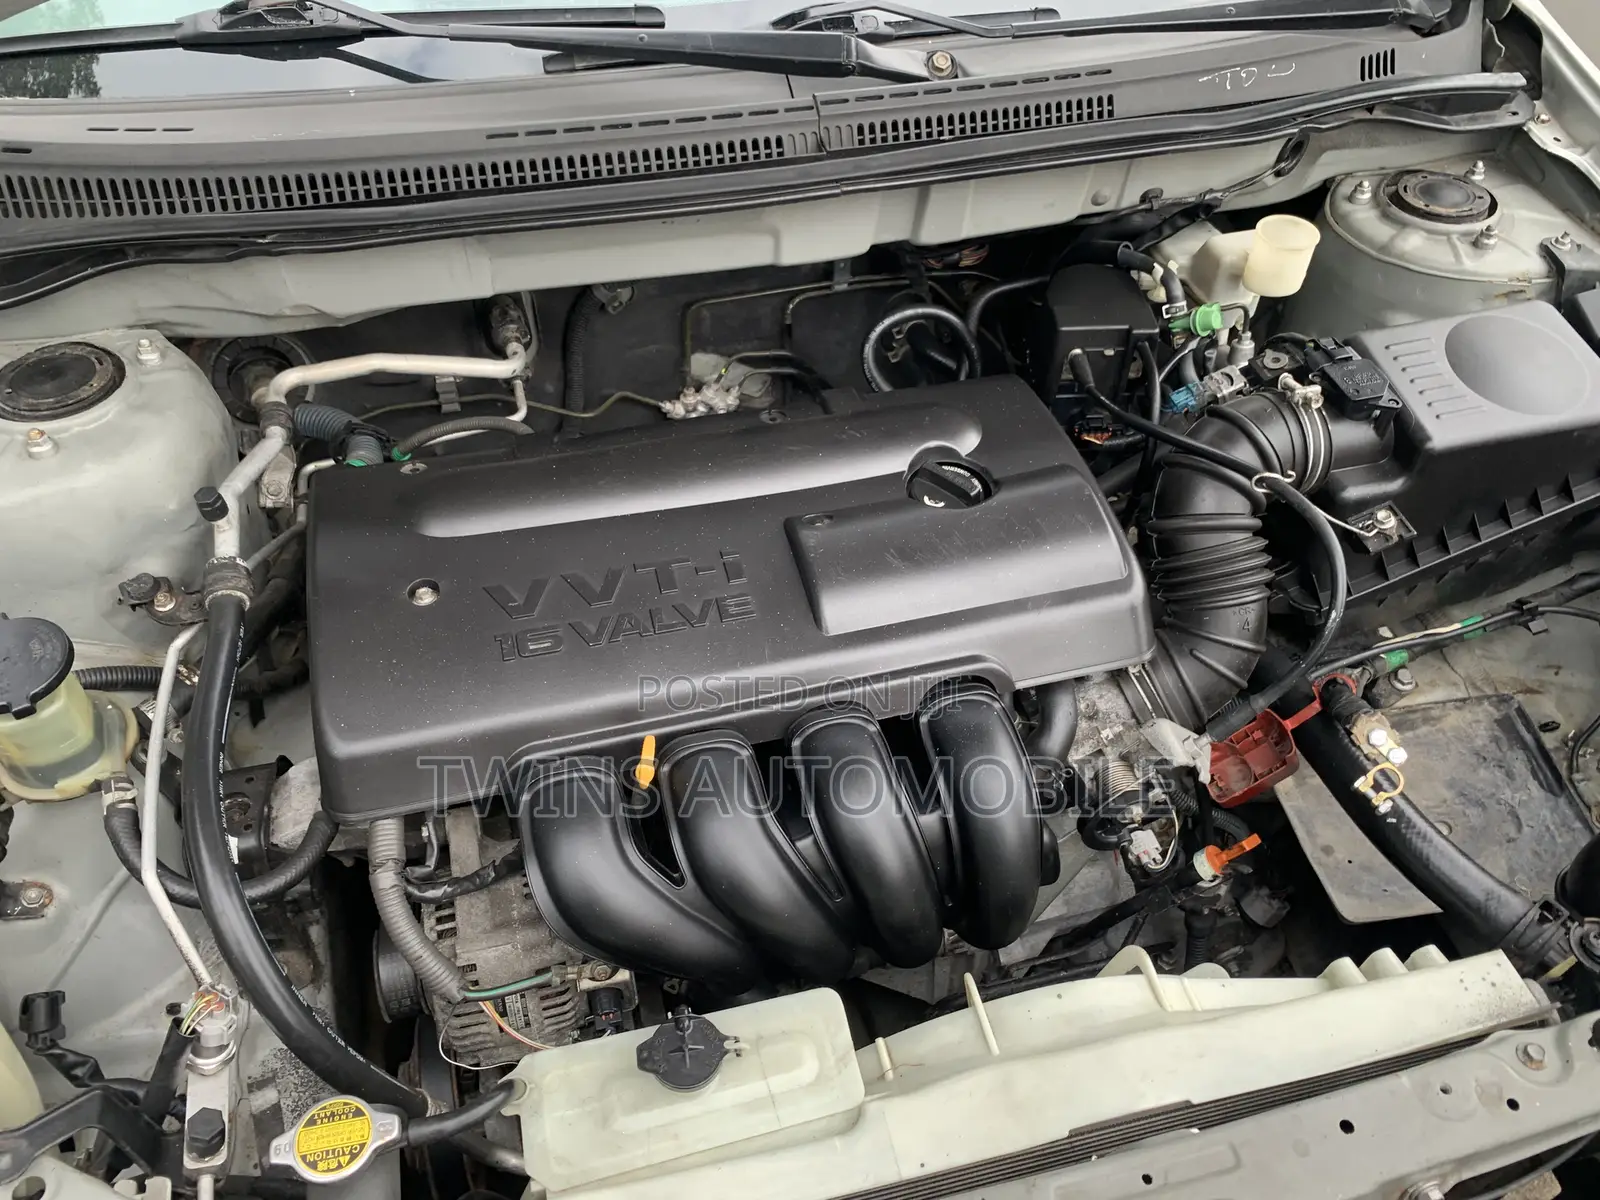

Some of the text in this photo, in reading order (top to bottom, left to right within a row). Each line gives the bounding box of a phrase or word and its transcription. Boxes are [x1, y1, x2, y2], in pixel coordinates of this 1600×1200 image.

[482, 550, 748, 620] VVT-i
[494, 595, 757, 662] 16 VALVE
[1242, 617, 1251, 632] 4
[313, 1106, 356, 1120] COOLANT
[316, 1112, 353, 1125] ENGINE
[306, 1145, 360, 1163] CAUTION
